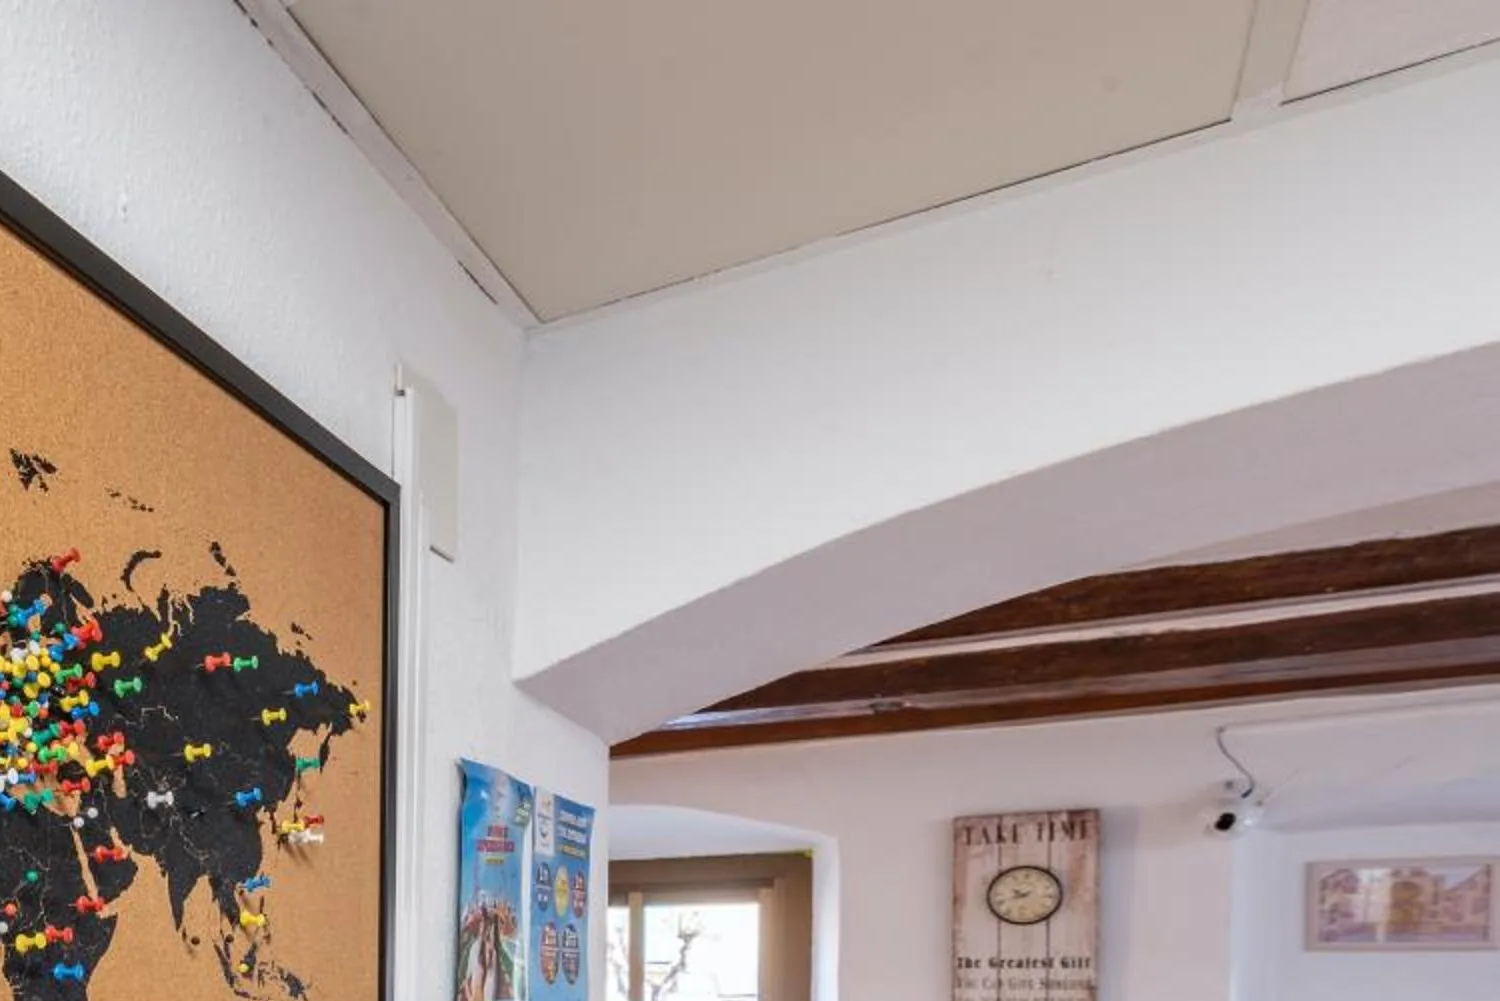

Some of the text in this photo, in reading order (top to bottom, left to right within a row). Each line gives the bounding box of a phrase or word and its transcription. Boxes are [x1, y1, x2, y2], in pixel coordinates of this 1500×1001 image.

[1036, 819, 1088, 842] TIME
[957, 957, 981, 969] The
[987, 957, 1055, 969] Greatest
